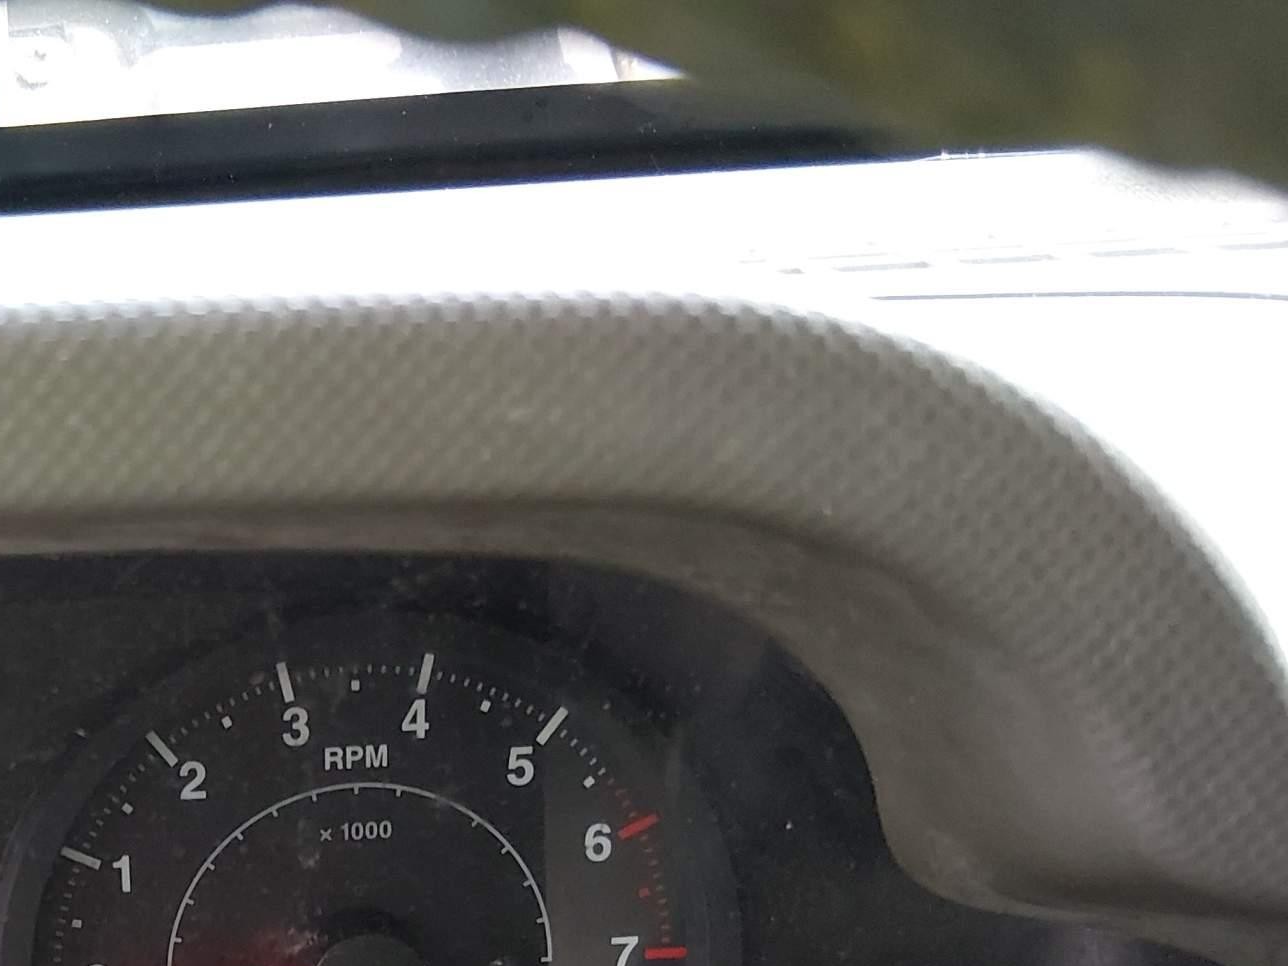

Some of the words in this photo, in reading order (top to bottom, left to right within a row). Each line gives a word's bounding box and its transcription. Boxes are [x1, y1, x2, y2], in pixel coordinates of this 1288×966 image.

[282, 706, 310, 746] 3
[401, 698, 430, 739] 4
[324, 743, 389, 771] RPM
[506, 745, 534, 786] 5
[179, 761, 207, 801] 2
[341, 820, 393, 841] 1000
[584, 823, 612, 862] 6
[112, 854, 132, 893] 1
